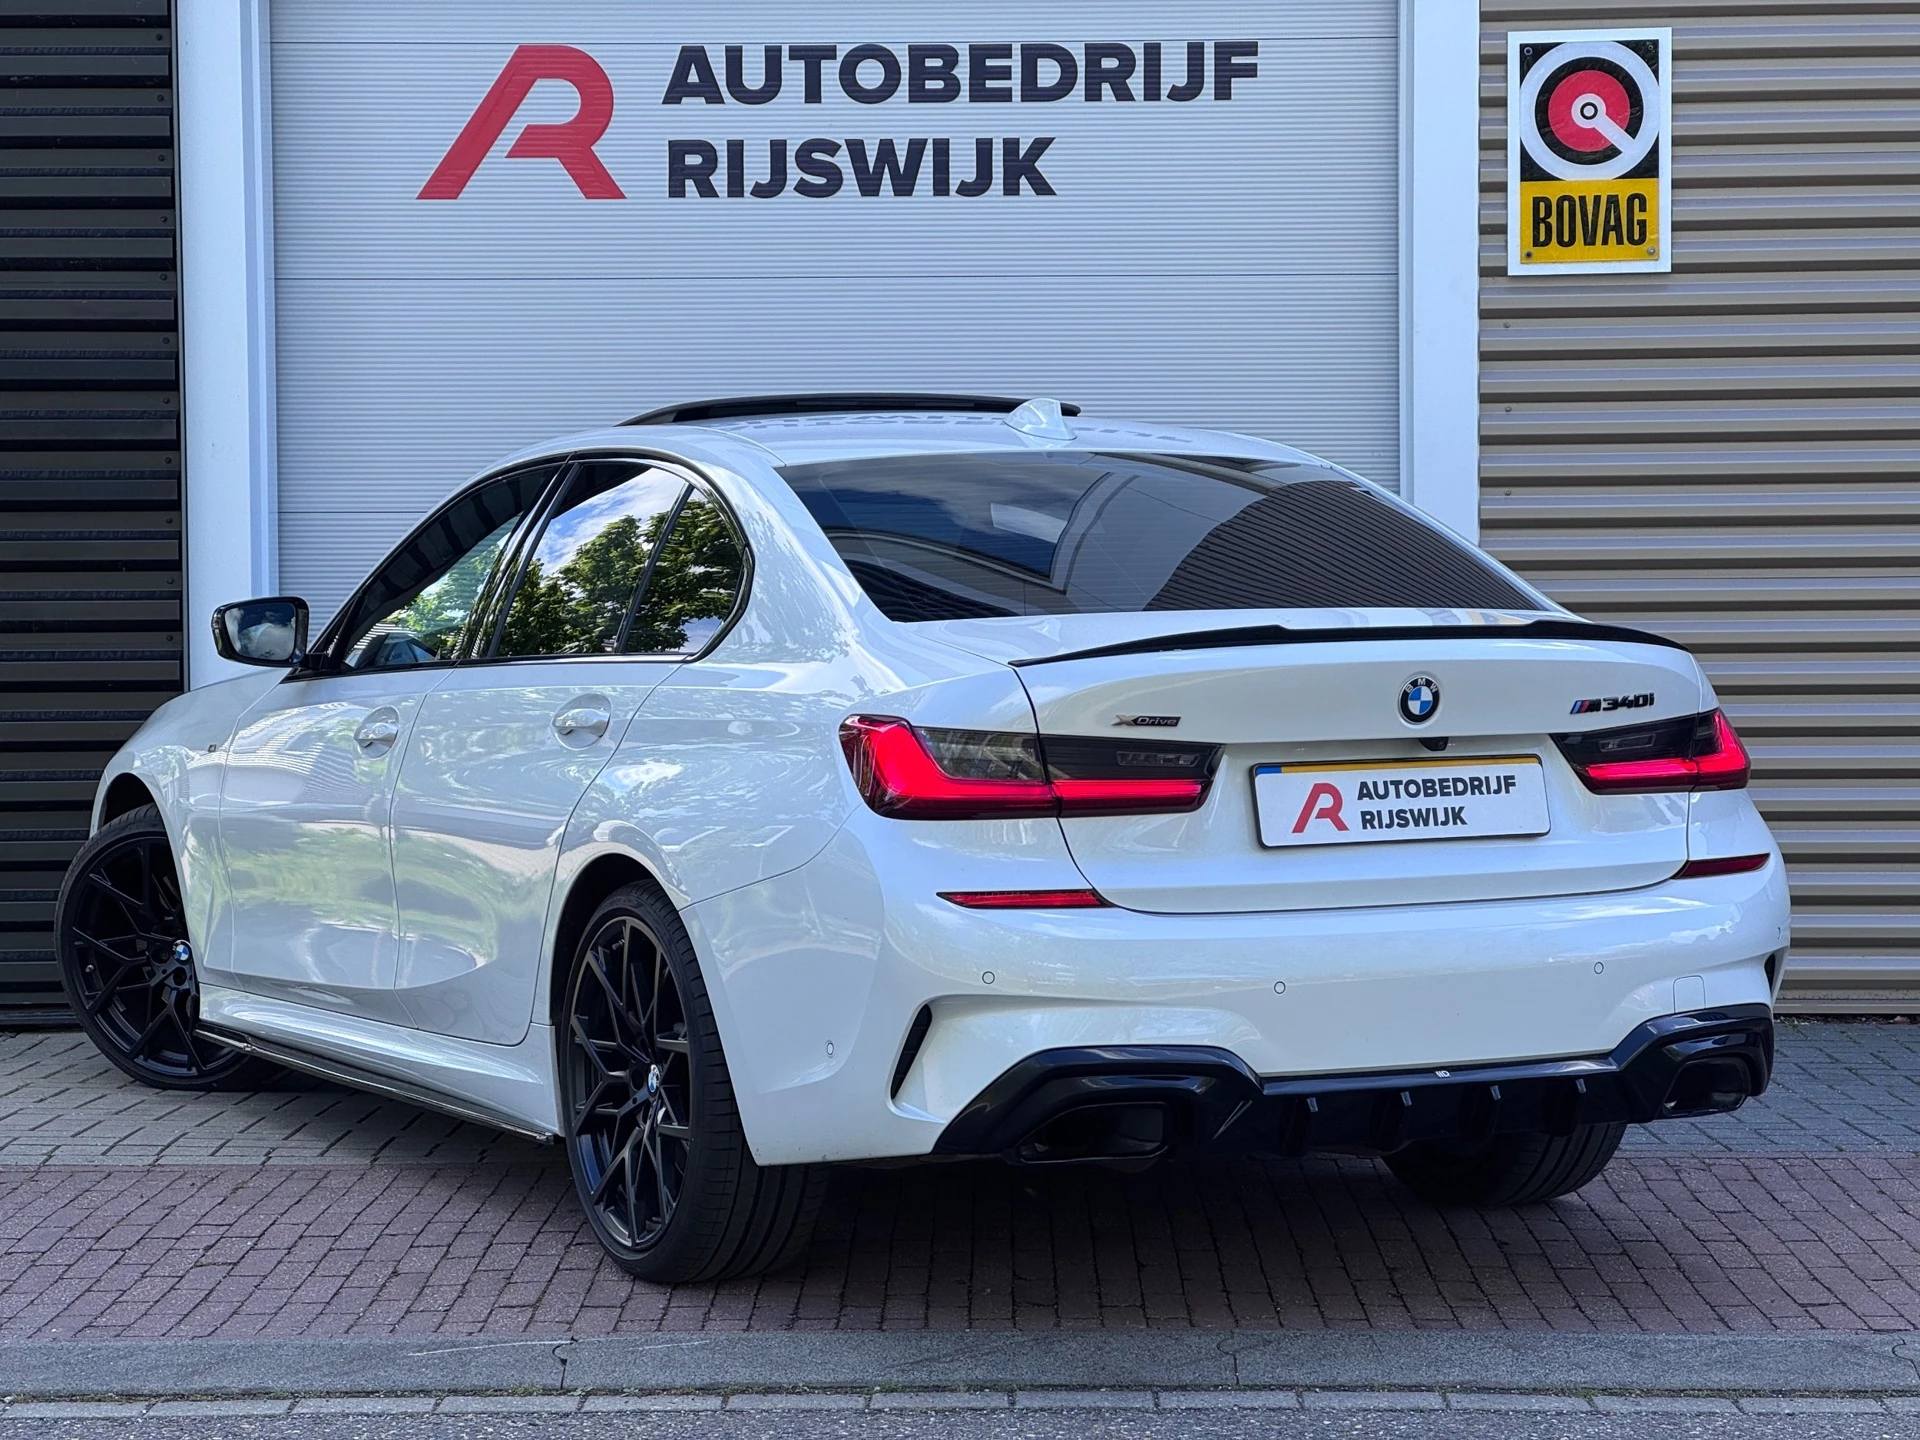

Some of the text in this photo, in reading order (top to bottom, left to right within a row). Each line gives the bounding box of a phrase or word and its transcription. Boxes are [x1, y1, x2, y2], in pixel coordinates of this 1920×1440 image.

[662, 42, 1259, 105] AUTOBEDRIJF
[667, 137, 1057, 199] RIJSWIJK
[1532, 194, 1647, 248] BOVAG
[1404, 678, 1438, 693] BMW
[1357, 775, 1517, 801] AUTOBEDRIJF
[1360, 806, 1467, 830] RIJSWIJK
